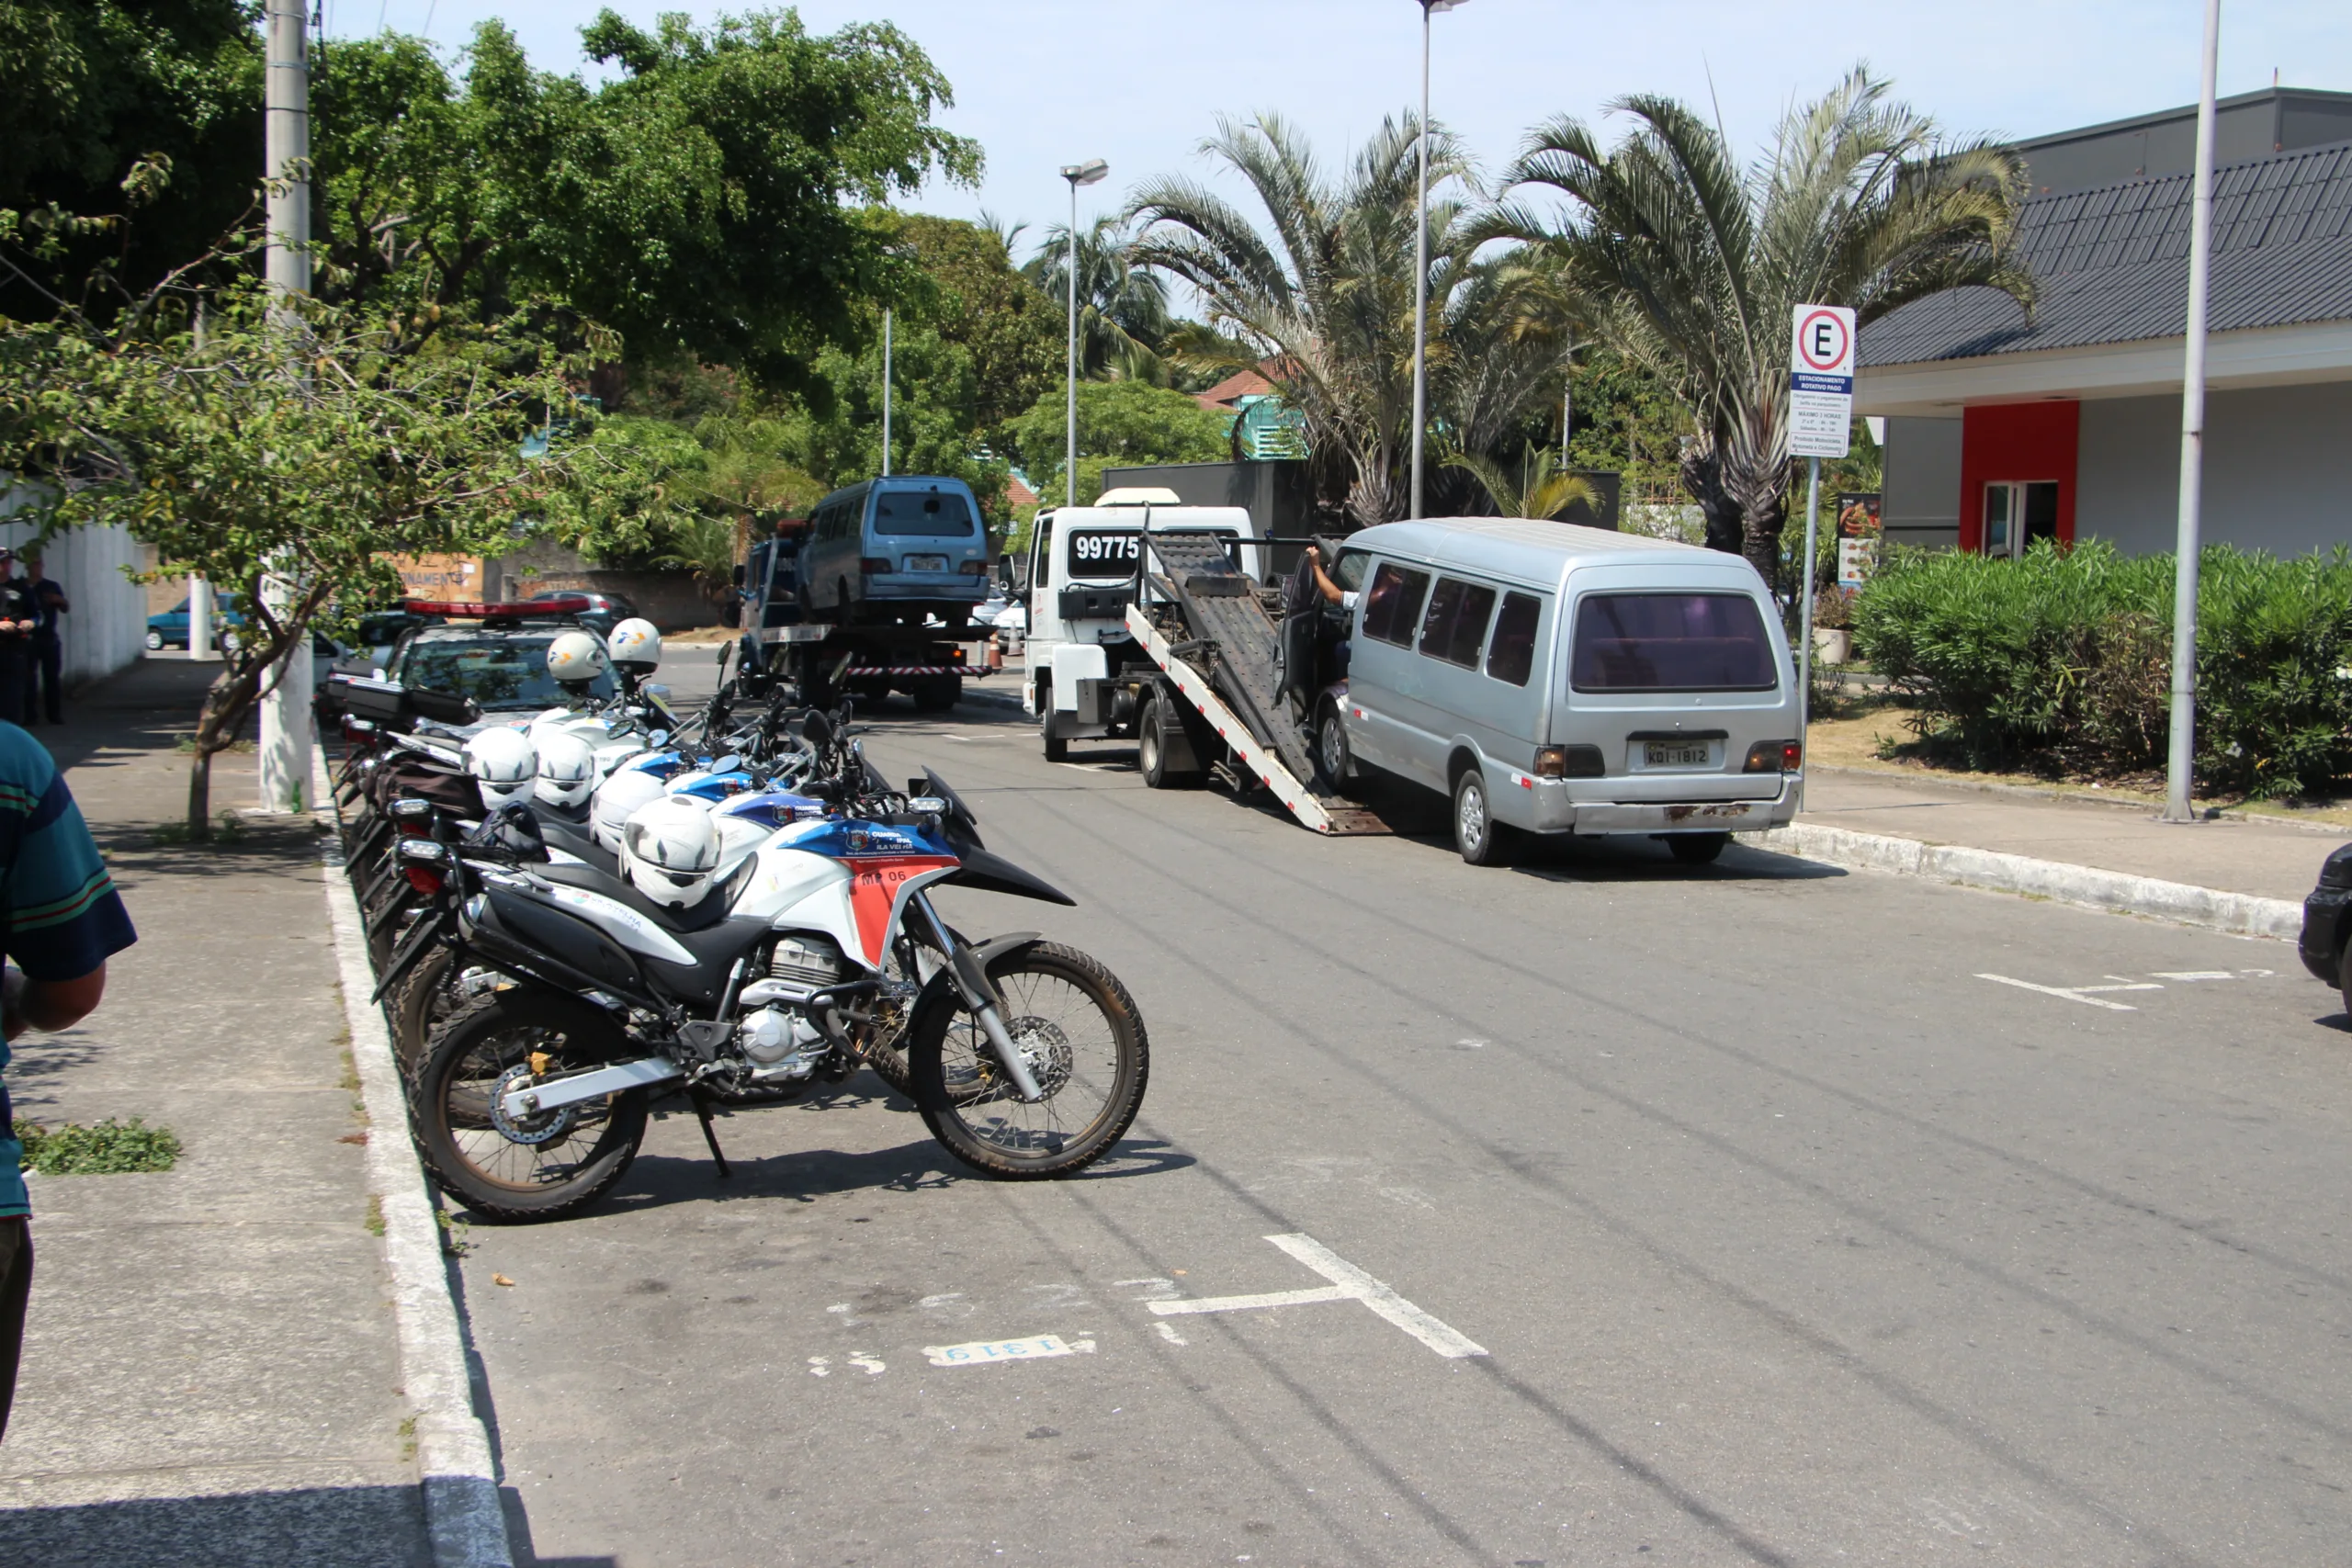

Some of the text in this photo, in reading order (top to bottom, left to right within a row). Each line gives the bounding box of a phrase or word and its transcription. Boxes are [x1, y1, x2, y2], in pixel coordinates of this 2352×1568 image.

[1815, 323, 1832, 356] E
[1798, 374, 1846, 384] ESTACIONAMENTO
[1801, 382, 1826, 390] ROTATIVO
[1076, 536, 1139, 559] 99775
[888, 871, 907, 882] 06
[945, 1339, 1059, 1360] 1319
